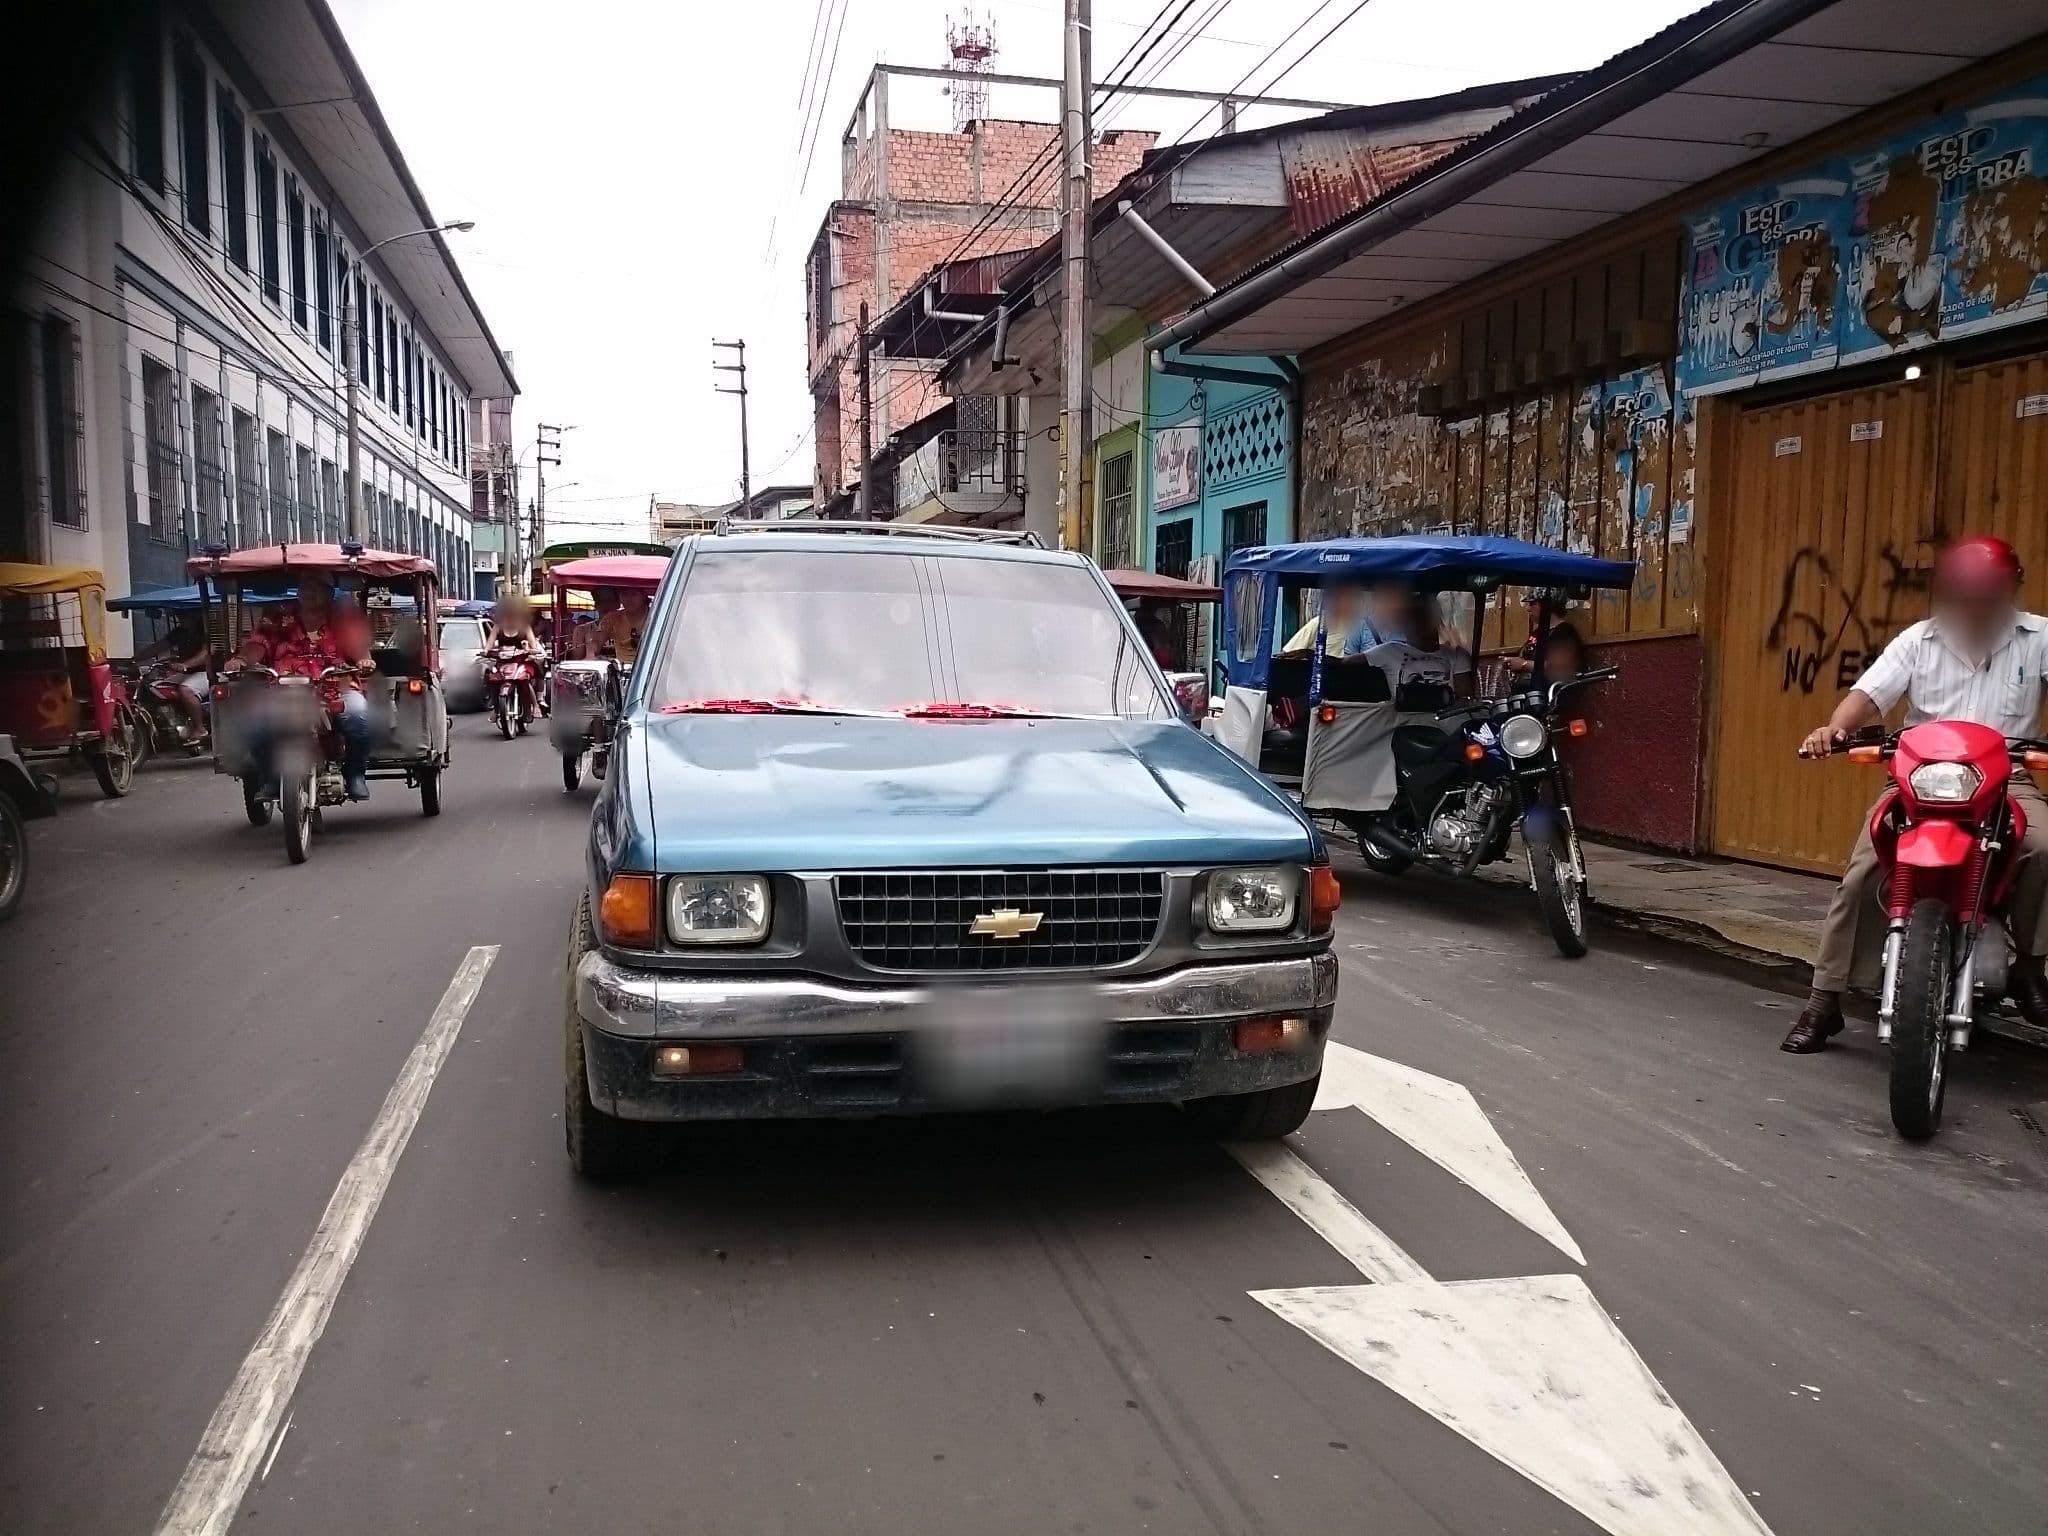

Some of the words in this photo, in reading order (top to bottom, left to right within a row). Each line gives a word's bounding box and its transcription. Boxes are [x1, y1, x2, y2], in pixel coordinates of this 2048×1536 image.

[1918, 128, 1997, 171] ESTO
[1944, 156, 1973, 180] es
[1743, 200, 1800, 235] ESTO
[1761, 224, 1783, 244] es
[592, 548, 606, 556] SAN
[607, 547, 628, 557] JUAN
[1324, 554, 1350, 562] MOTOKAR
[1782, 645, 1818, 695] NO
